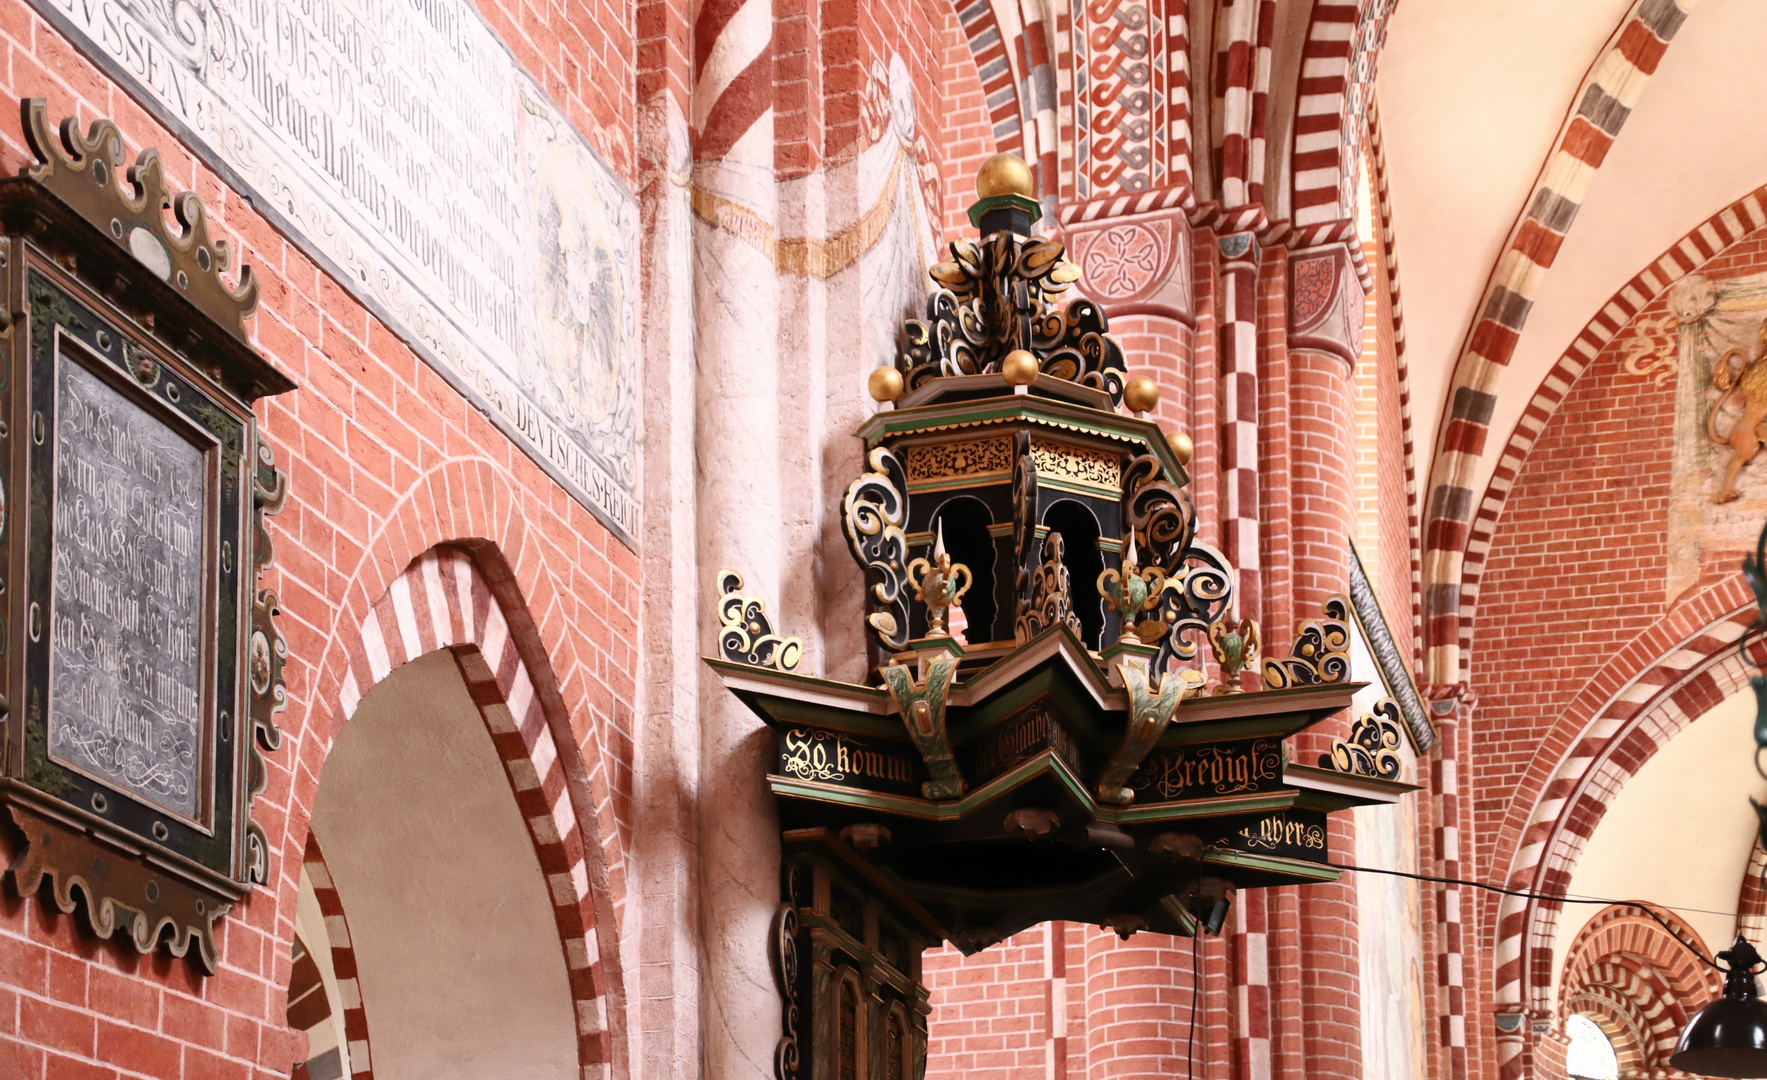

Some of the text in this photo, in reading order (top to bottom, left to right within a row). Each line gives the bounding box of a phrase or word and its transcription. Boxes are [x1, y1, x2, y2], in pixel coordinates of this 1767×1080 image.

[59, 0, 188, 119] VSSEN
[208, 0, 319, 163] Wilhelms
[63, 374, 96, 437] Die
[95, 404, 136, 468] Gnade
[56, 491, 73, 540] die
[73, 493, 108, 561] Liebe
[153, 554, 173, 601] und
[176, 560, 191, 611] die
[58, 433, 194, 562] Herrn Jesu Christi, und
[77, 613, 131, 684] Geistes
[135, 656, 152, 699] sei
[157, 667, 177, 712] mit
[176, 681, 197, 726] uns
[143, 594, 161, 651] des
[1156, 739, 1264, 800] Predigt
[1260, 815, 1305, 846] aber
